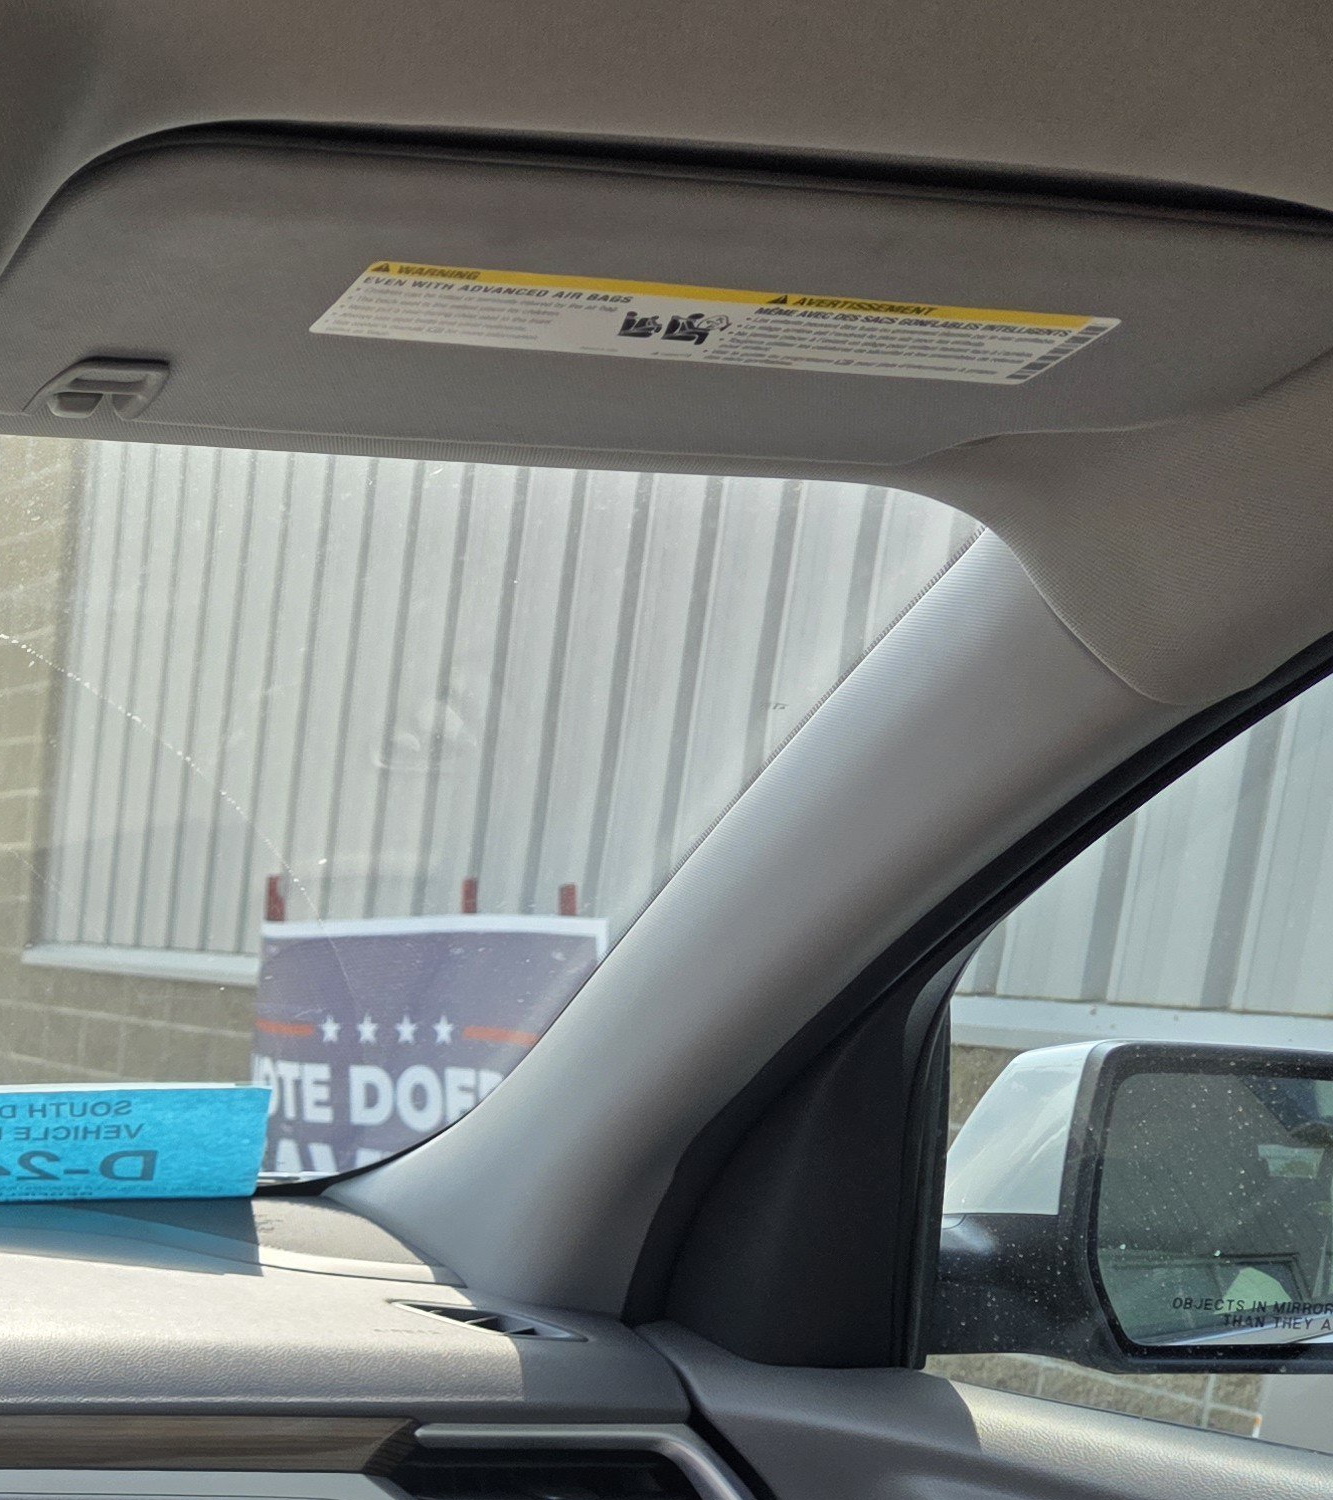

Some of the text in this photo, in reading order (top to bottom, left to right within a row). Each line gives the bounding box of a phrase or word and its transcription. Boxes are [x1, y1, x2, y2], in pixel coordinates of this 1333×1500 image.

[397, 265, 481, 281] WARNING
[363, 276, 635, 304] EVEN WITH ADVANCED AIR BAGS
[795, 296, 937, 316] AVERTISSEMENT
[1172, 1296, 1333, 1315] OBJECTS IN MIRROR
[1224, 1313, 1265, 1328] THAN
[1274, 1316, 1314, 1330] THEY
